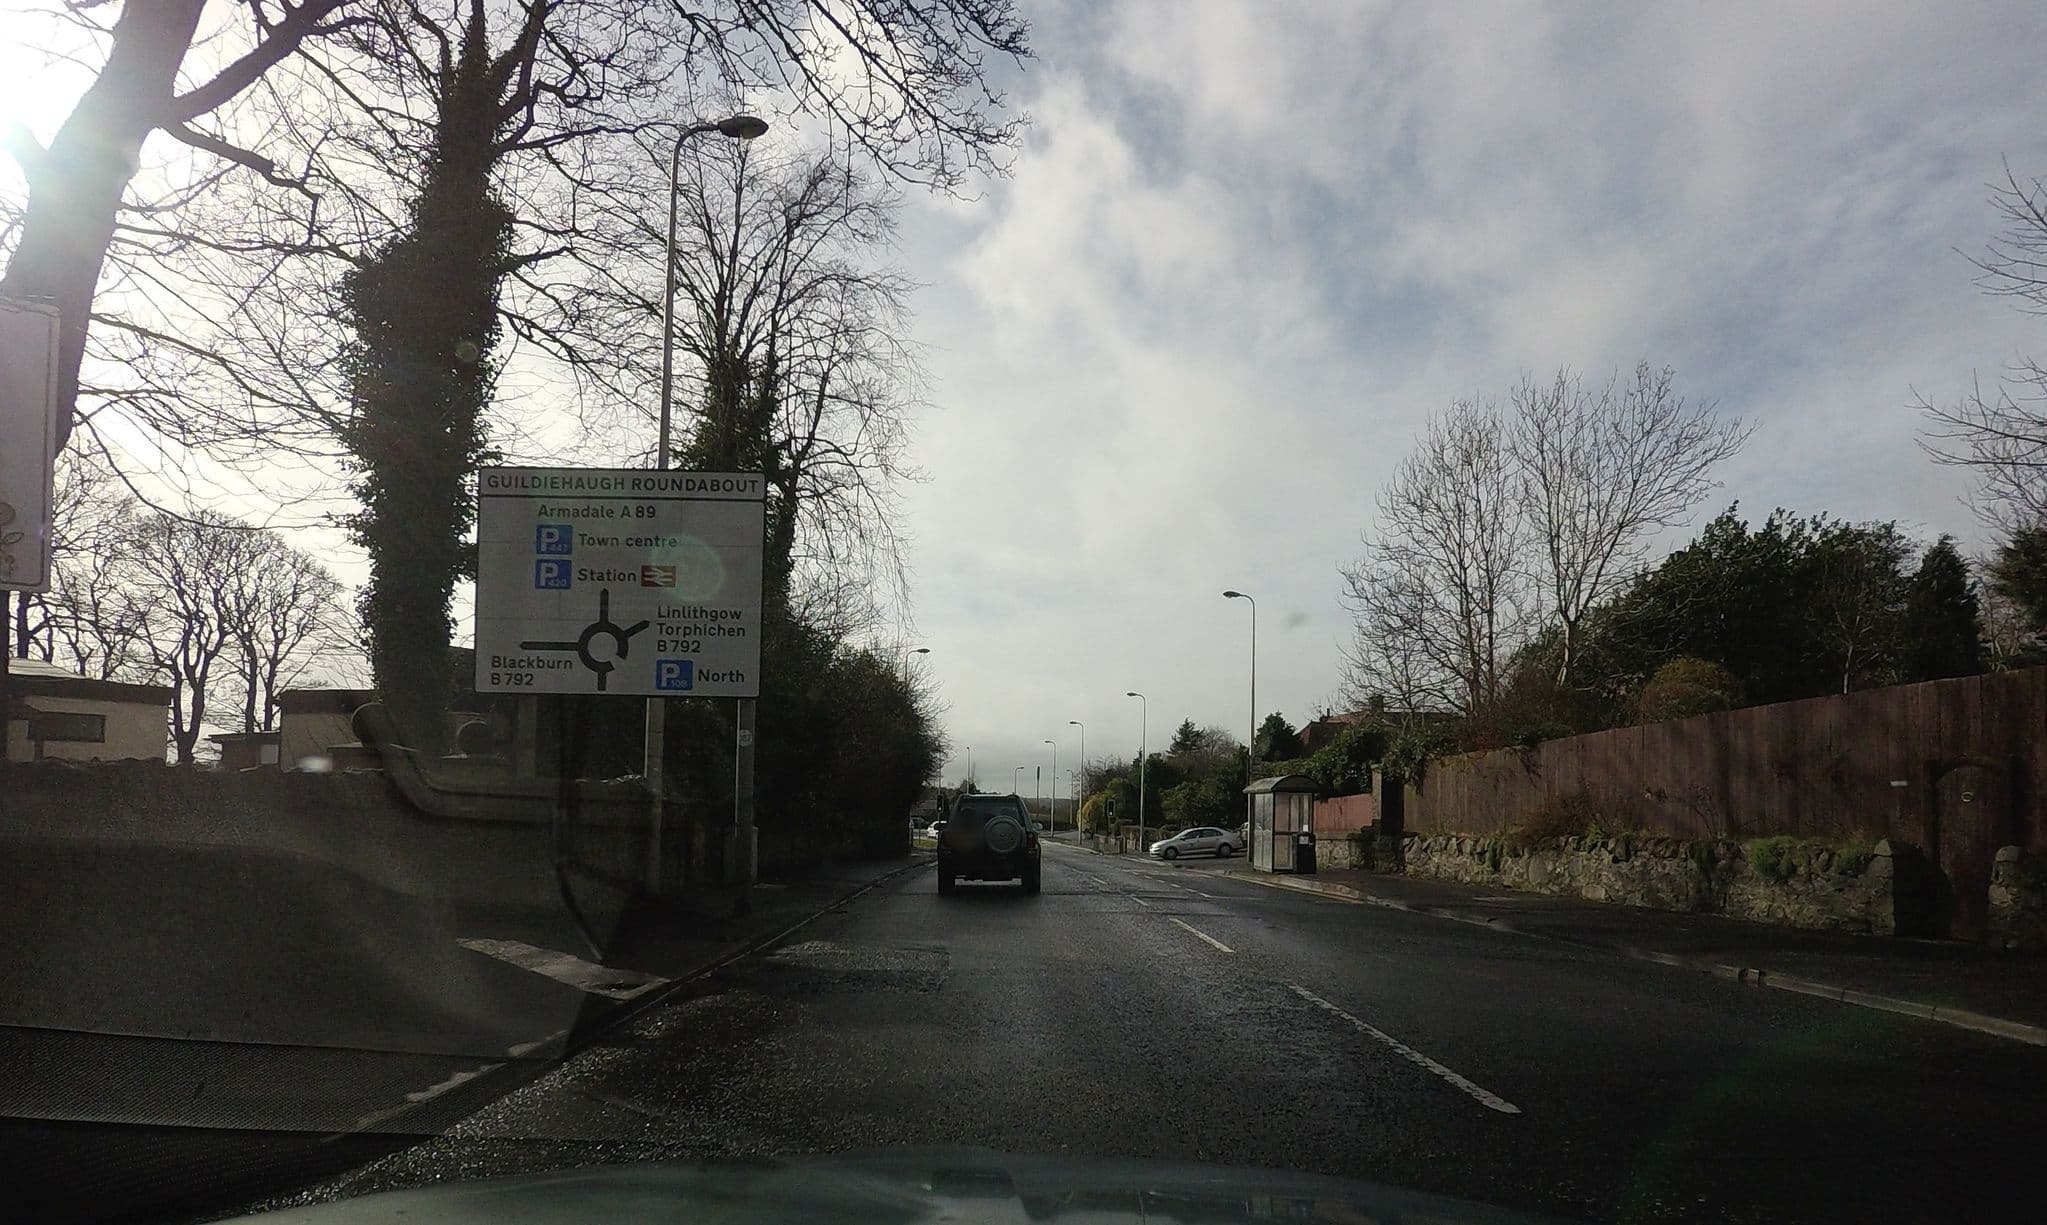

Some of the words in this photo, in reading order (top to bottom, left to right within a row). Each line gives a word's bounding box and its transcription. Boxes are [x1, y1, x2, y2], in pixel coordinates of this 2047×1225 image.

[487, 475, 625, 490] GUILDIEHAUGH
[631, 477, 759, 493] ROUNDABOUT
[538, 504, 614, 518] Armadale
[578, 533, 620, 547] Town
[625, 535, 678, 548] centre
[577, 568, 637, 582] Station
[657, 606, 742, 621] Linlithgow
[656, 622, 746, 638] Torphichen
[491, 655, 573, 669] Blackburn
[698, 668, 745, 683] North
